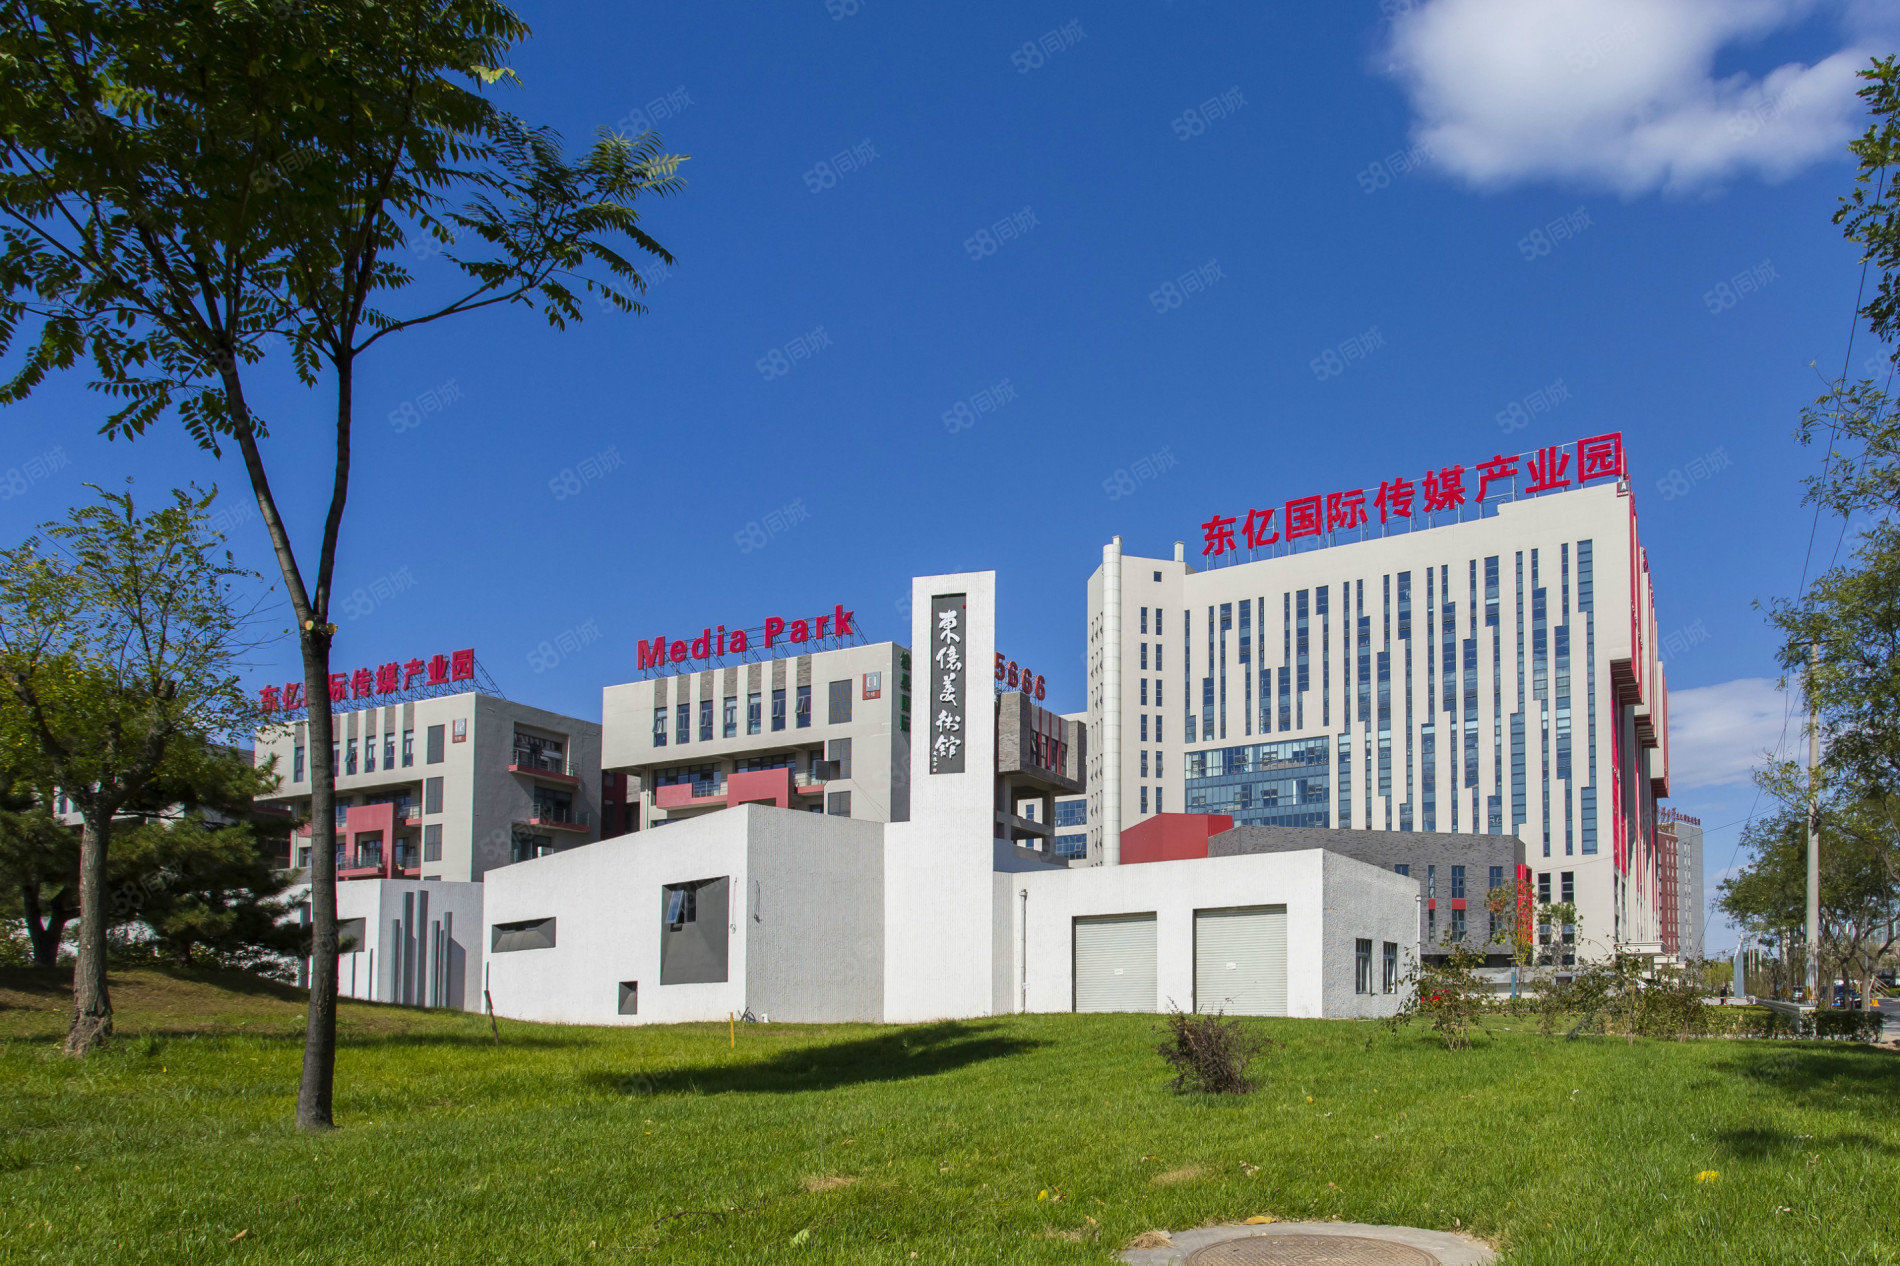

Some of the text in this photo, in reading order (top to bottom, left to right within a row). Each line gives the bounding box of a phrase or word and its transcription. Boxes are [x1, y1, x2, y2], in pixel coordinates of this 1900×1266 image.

[1201, 431, 1622, 556] 东亿国际传媒产业园
[637, 624, 748, 670] Media
[764, 604, 855, 648] Park
[259, 648, 475, 713] 东亿际传媒产业园
